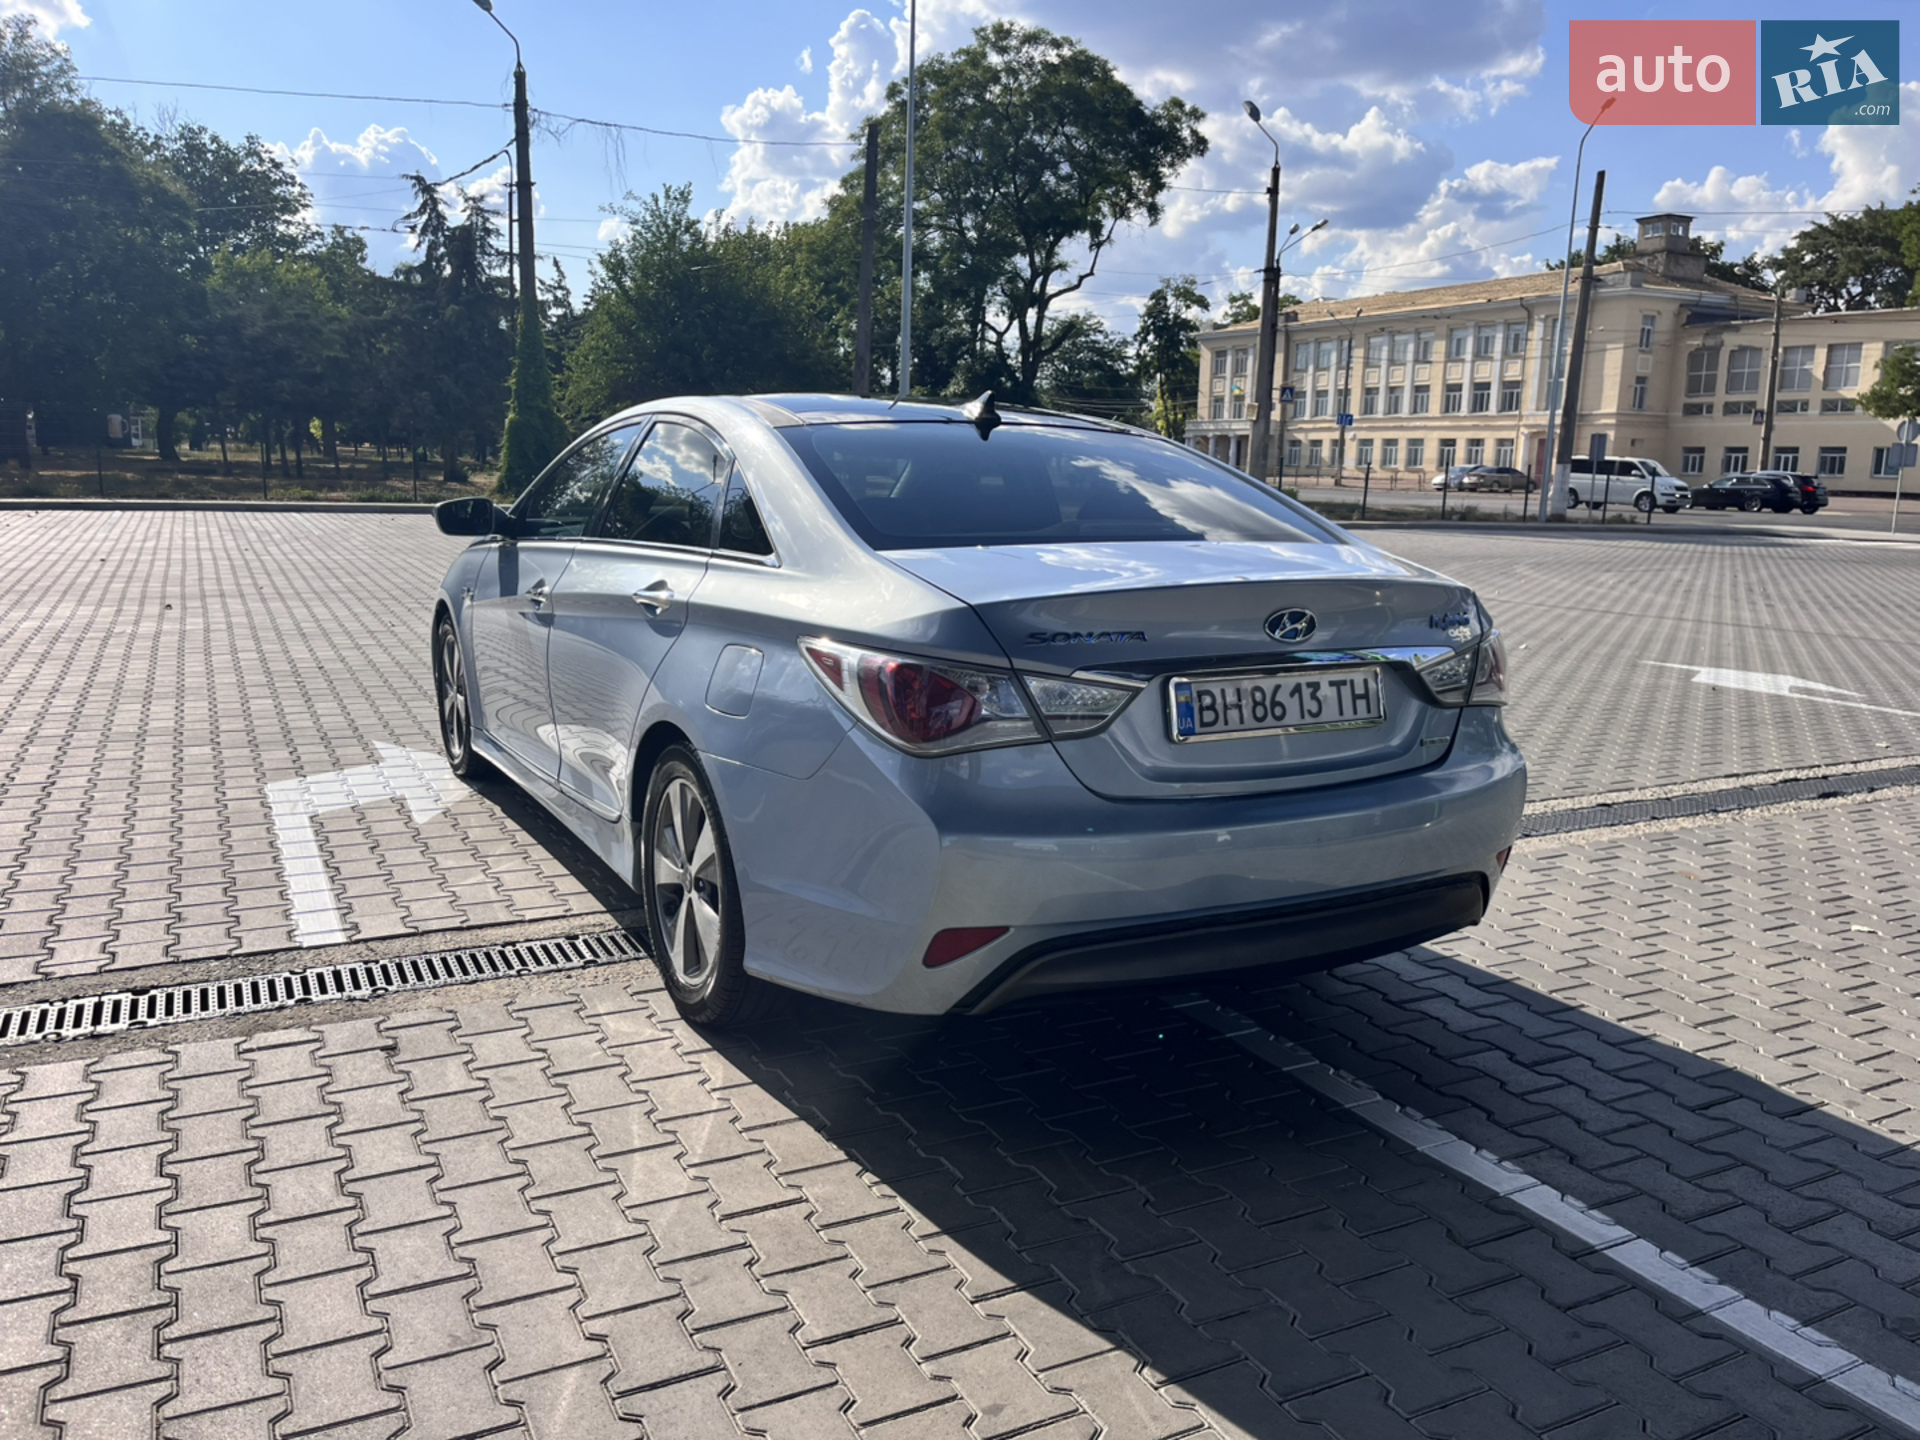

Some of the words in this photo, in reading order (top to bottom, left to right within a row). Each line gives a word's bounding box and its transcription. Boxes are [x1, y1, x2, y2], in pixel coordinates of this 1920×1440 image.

[1023, 631, 1148, 646] SONATA
[1251, 681, 1323, 723] 8613
[1178, 717, 1194, 730] UA
